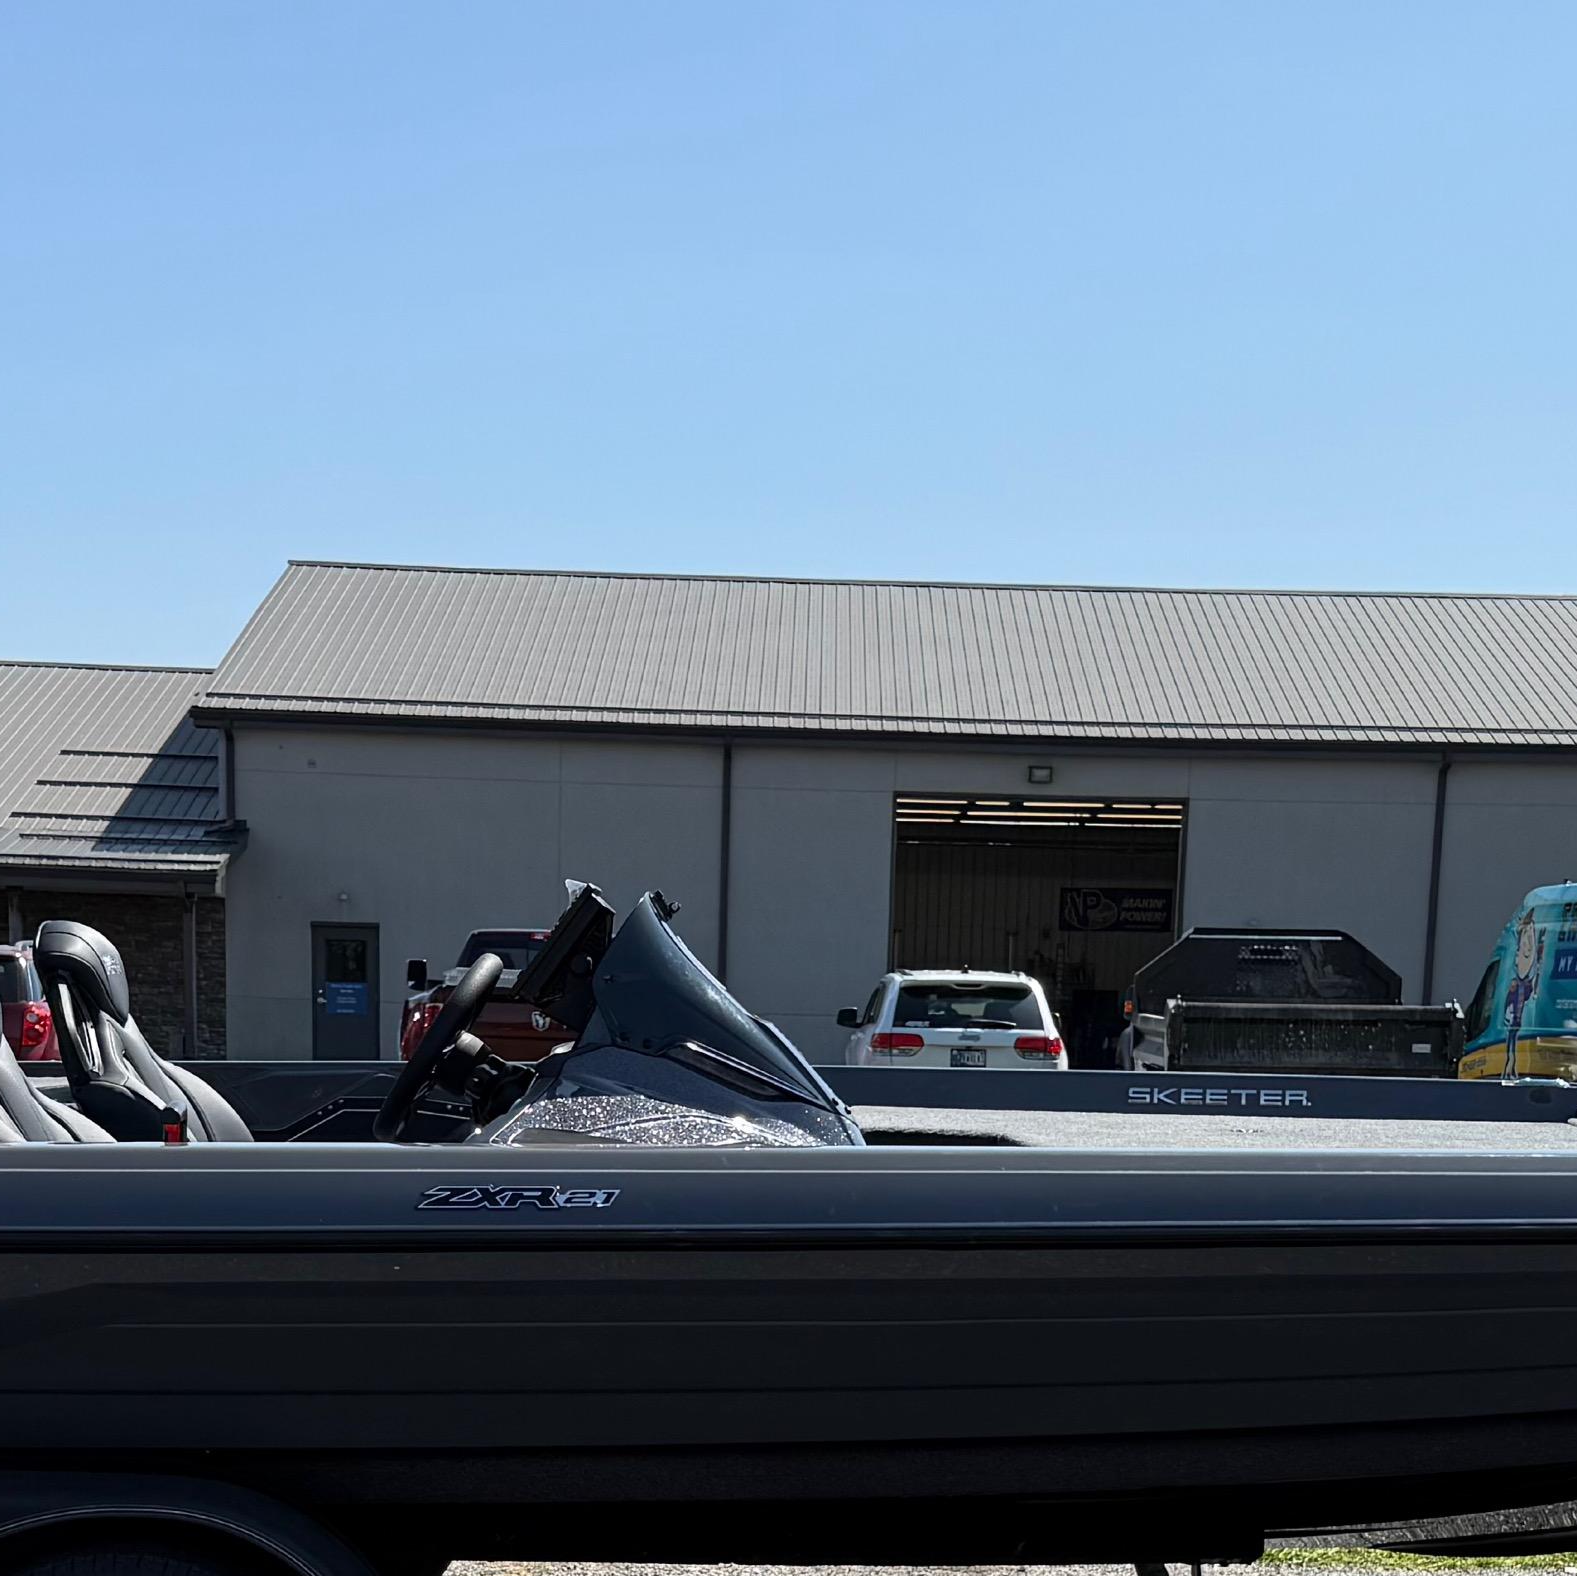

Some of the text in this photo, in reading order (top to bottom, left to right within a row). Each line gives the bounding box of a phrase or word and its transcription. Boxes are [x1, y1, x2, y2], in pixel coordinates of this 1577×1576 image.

[1558, 956, 1573, 973] MY
[1127, 1087, 1308, 1106] SKEETER
[417, 1185, 559, 1209] ZXR
